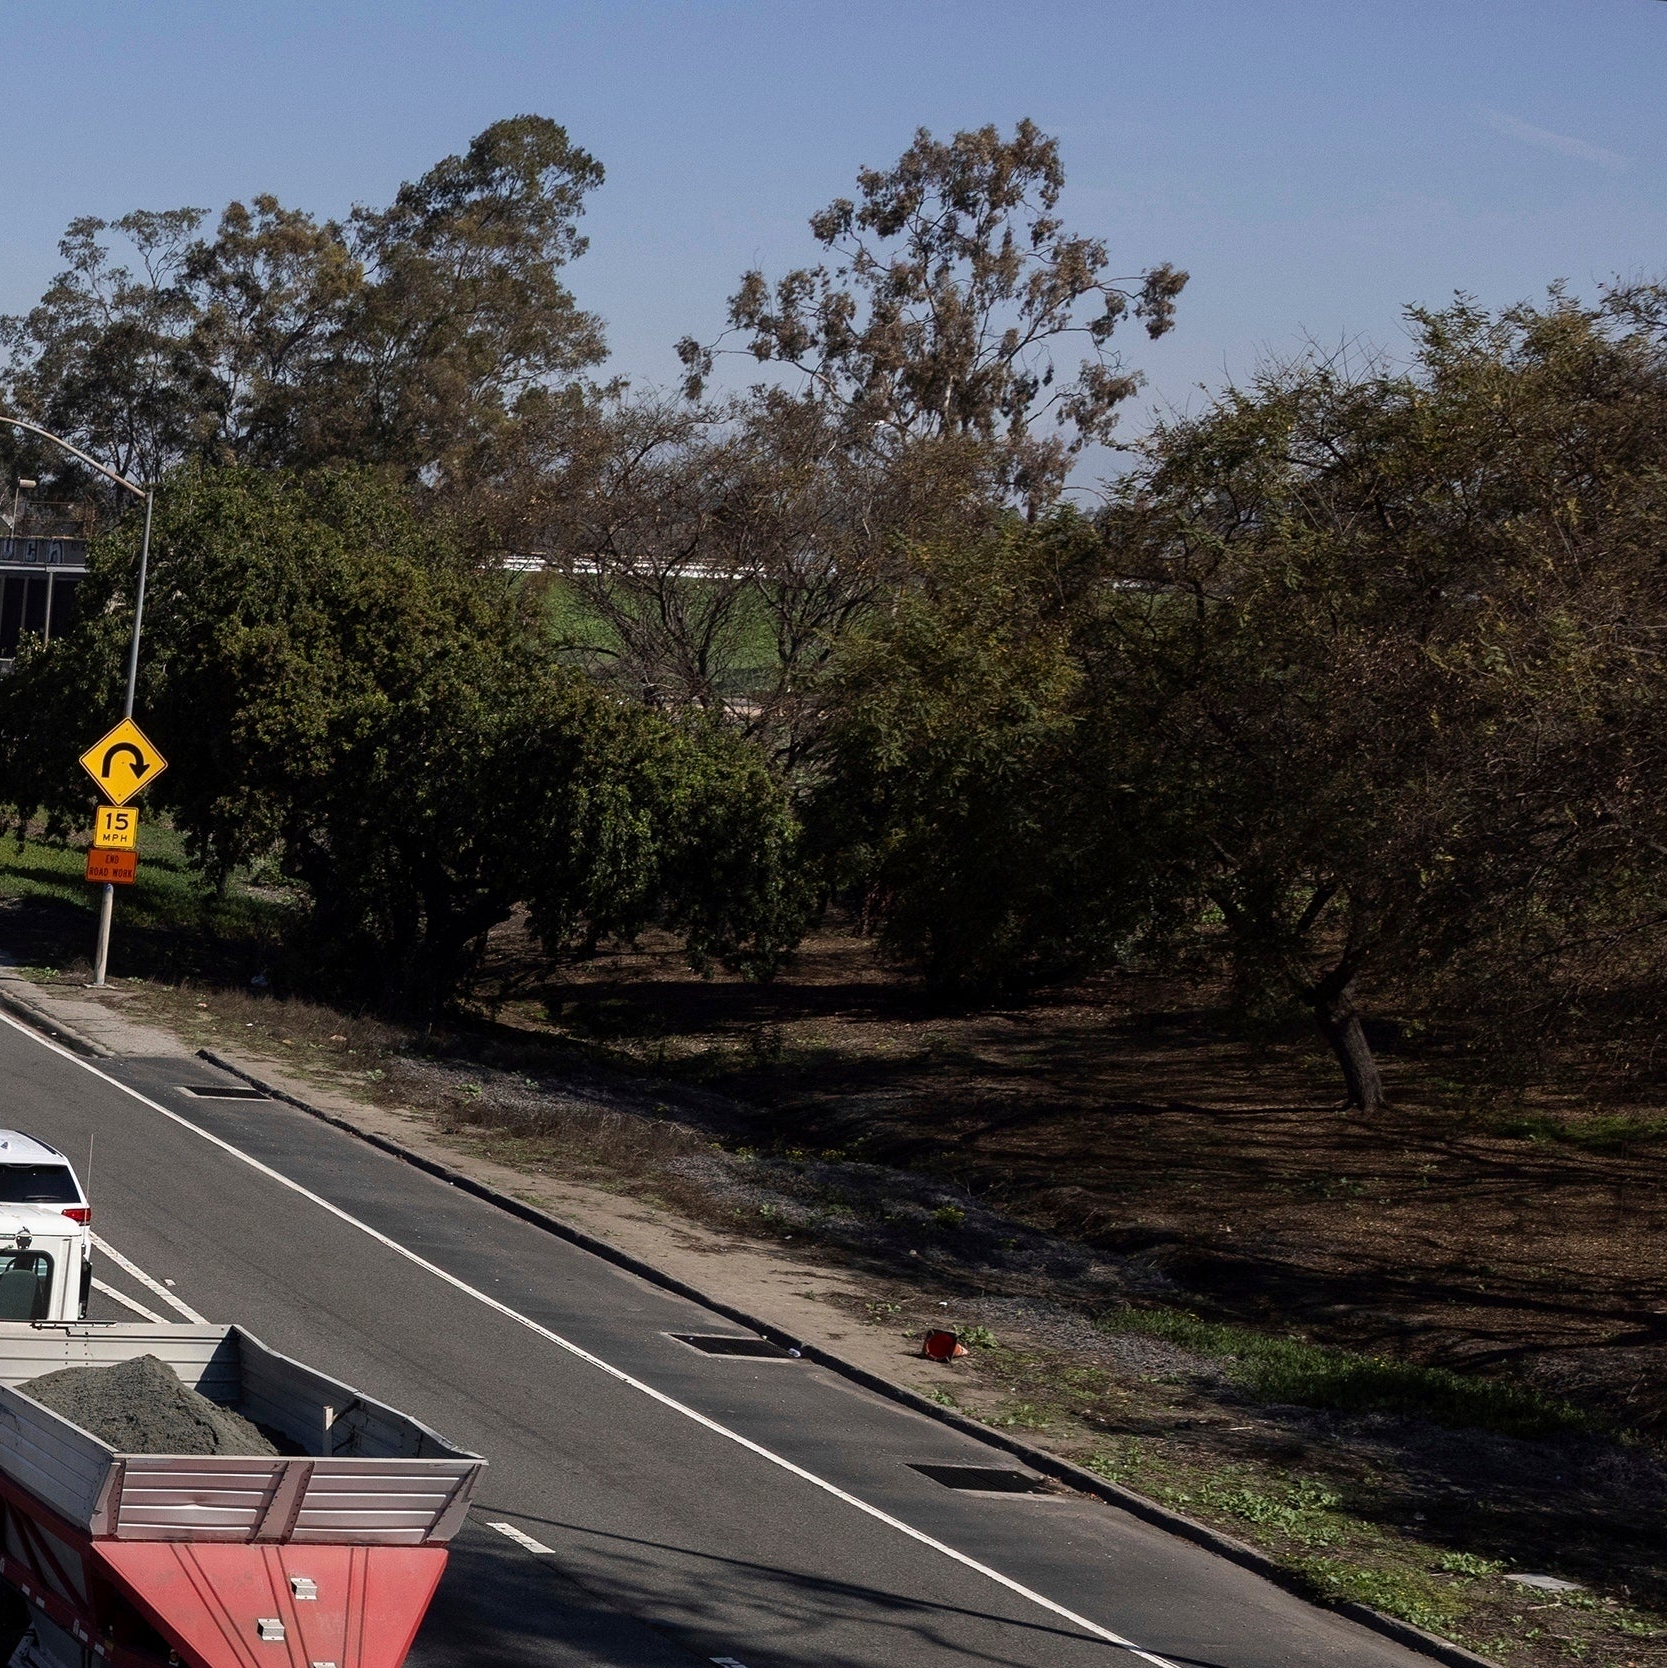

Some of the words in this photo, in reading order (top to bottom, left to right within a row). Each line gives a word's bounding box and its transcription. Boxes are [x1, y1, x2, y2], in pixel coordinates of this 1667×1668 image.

[105, 812, 129, 831] 15
[102, 833, 128, 843] MPH
[105, 854, 120, 865] END
[88, 866, 109, 877] ROAD
[113, 867, 133, 879] WORK
